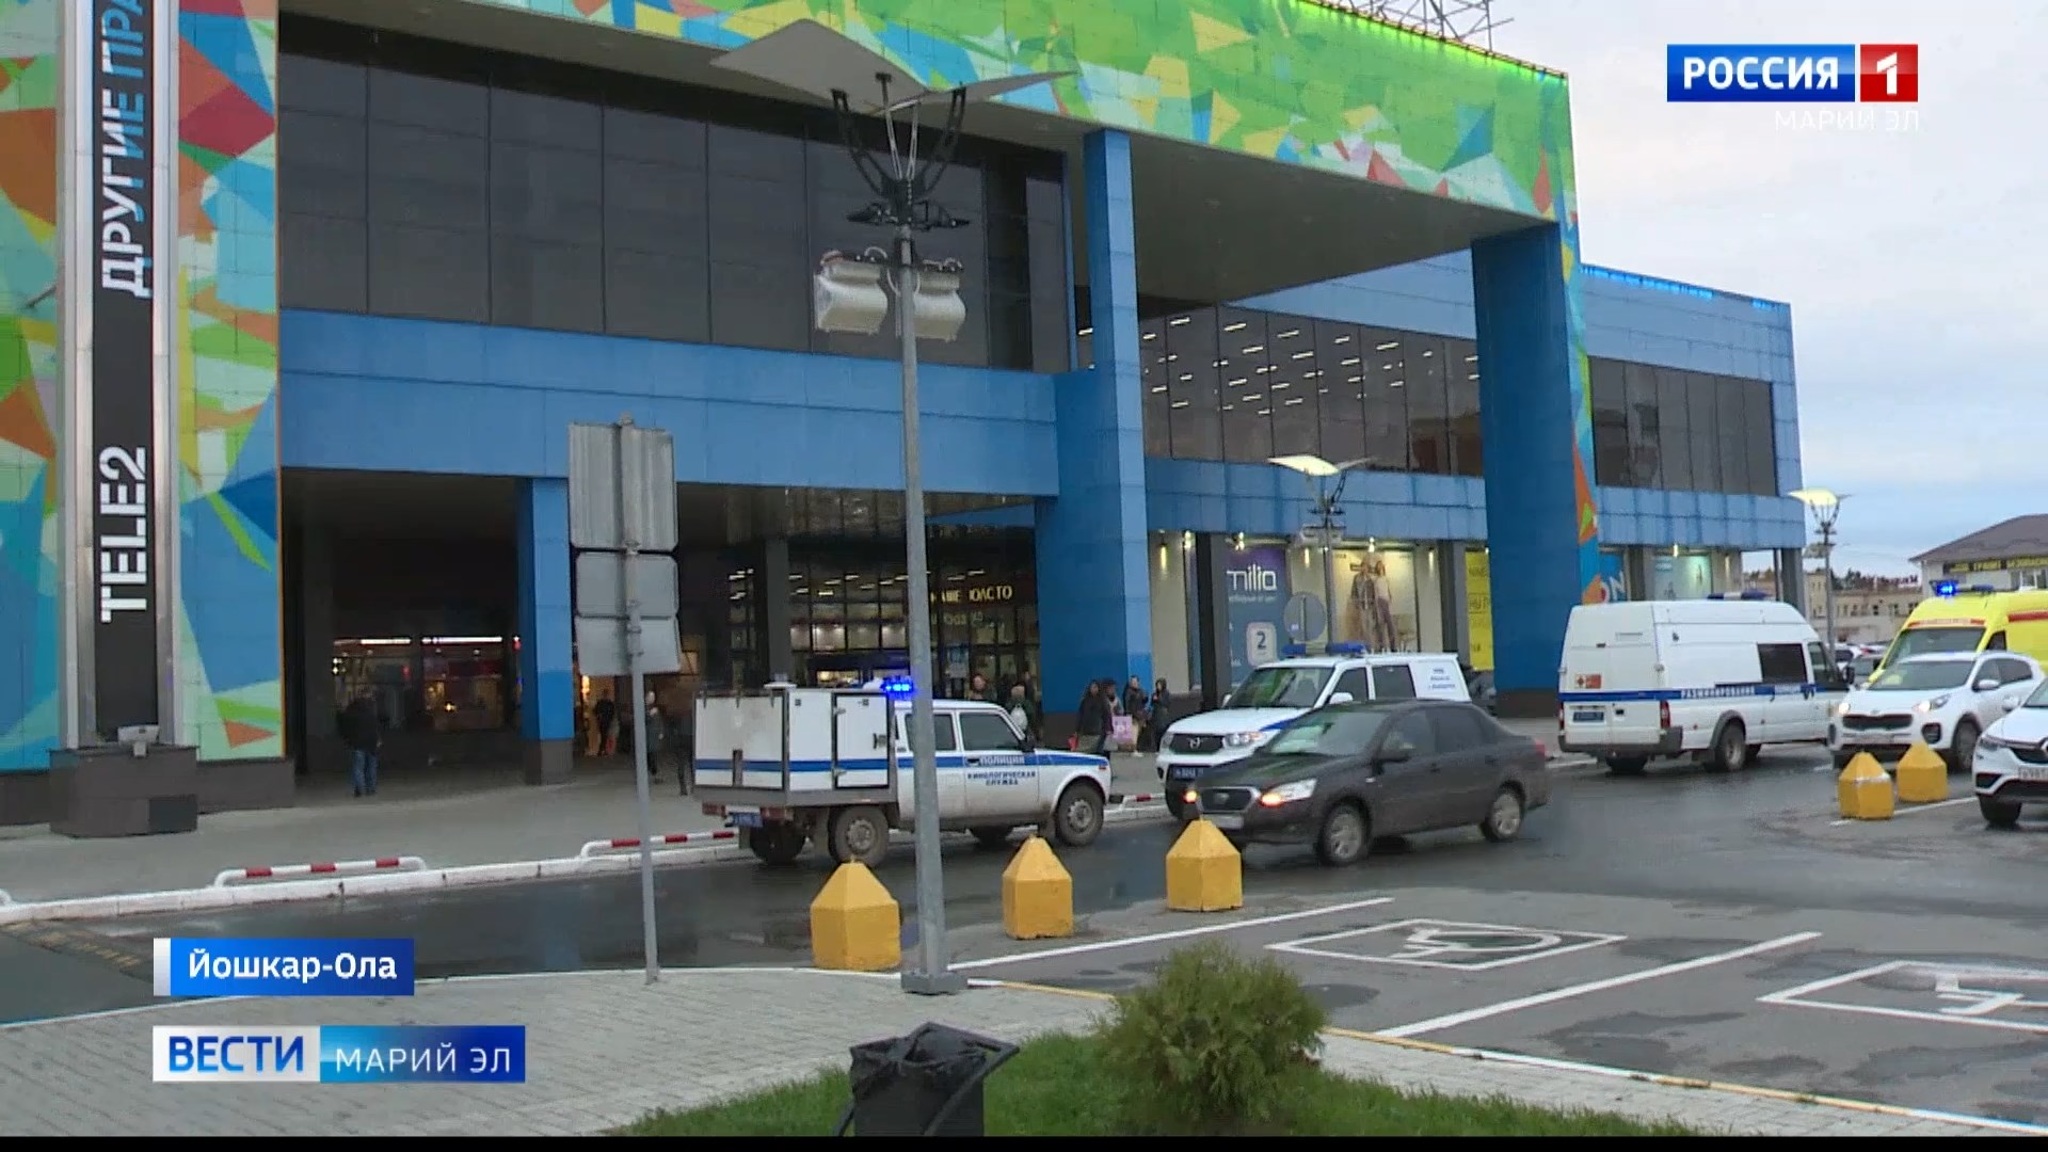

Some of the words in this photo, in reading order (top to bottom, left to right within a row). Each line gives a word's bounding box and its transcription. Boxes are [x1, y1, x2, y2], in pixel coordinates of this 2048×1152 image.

[102, 88, 153, 299] ДРУГИЕ
[99, 446, 147, 623] TELE2
[1256, 630, 1266, 650] 2
[980, 755, 1025, 766] ПОЛИЦИЯ
